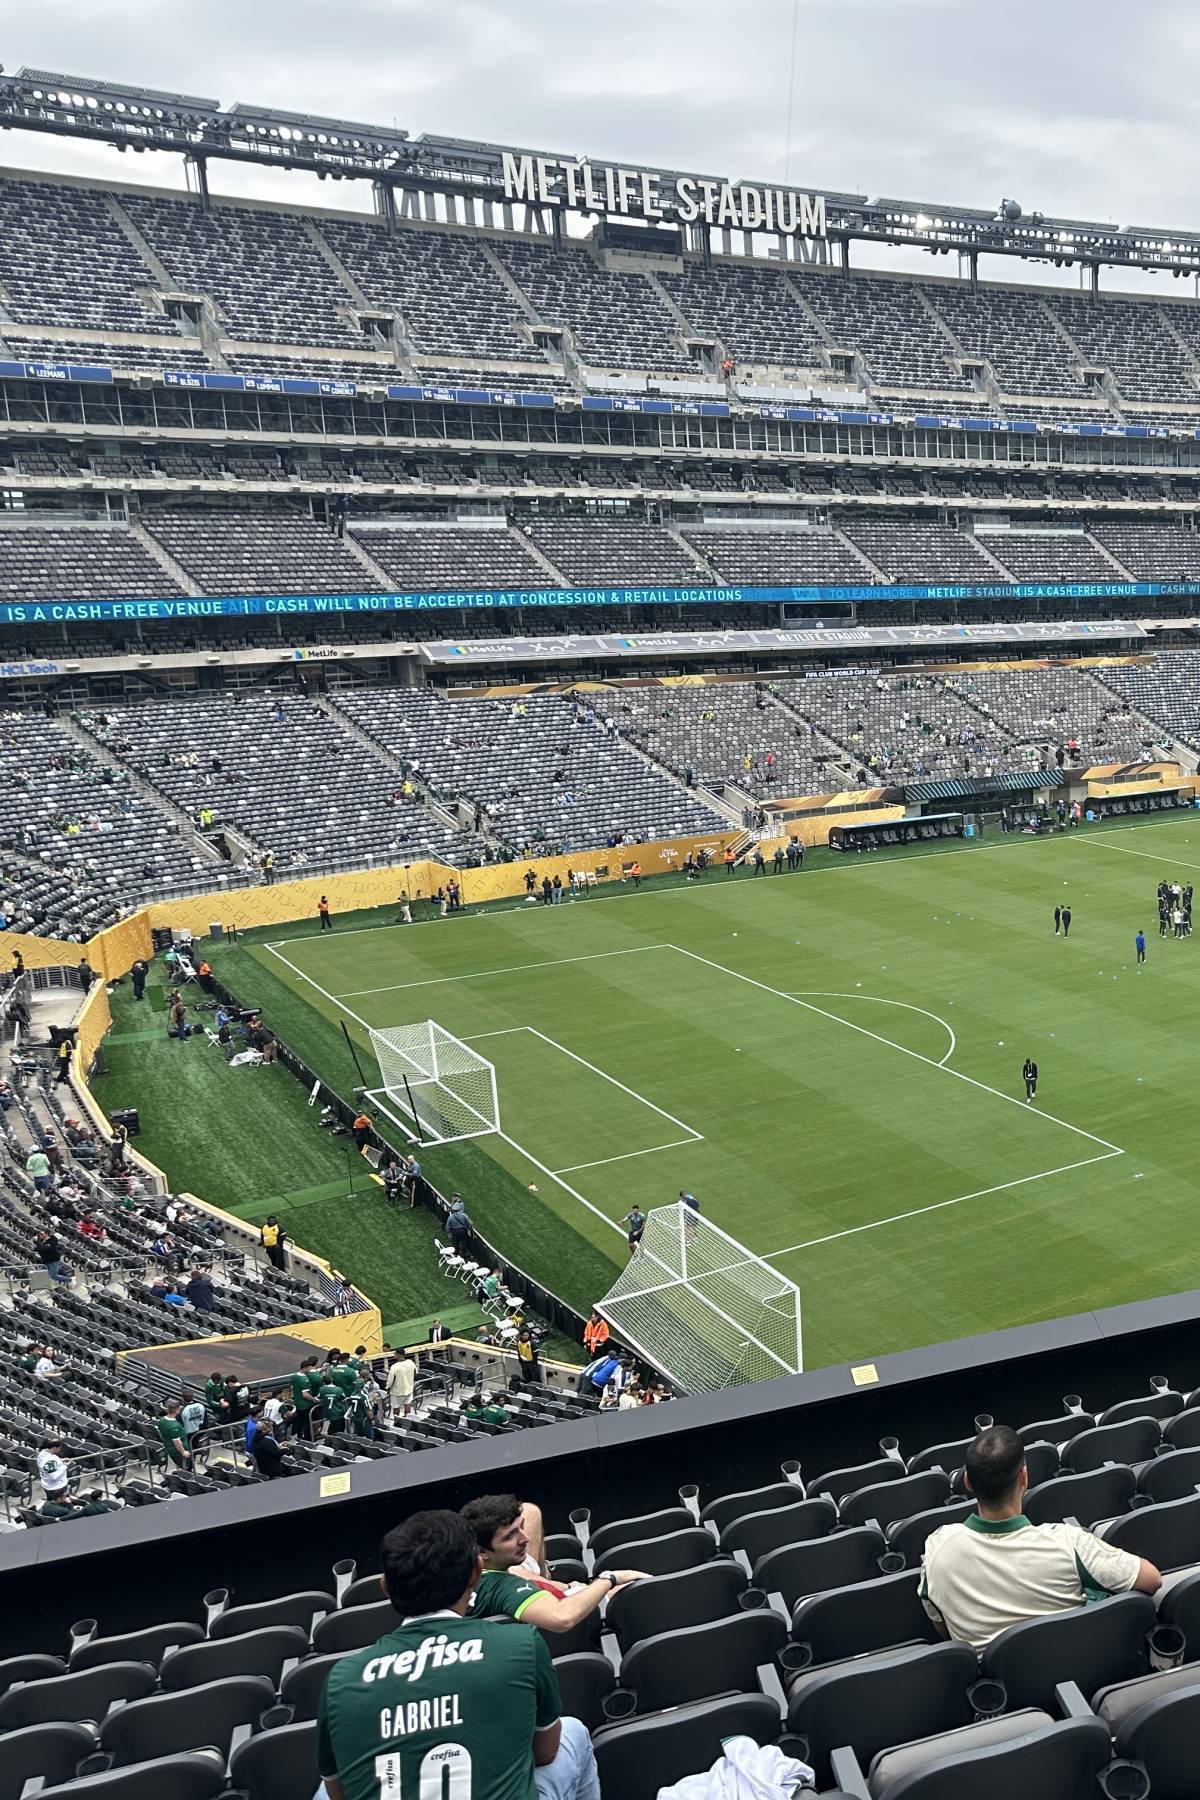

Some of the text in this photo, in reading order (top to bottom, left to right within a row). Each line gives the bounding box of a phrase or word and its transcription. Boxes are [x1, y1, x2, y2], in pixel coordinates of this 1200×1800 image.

[501, 151, 827, 237] METLIFE STADIUM
[167, 375, 178, 383] 32
[927, 588, 973, 598] METLIFE
[976, 586, 1020, 597] STADIUM
[1023, 587, 1033, 596] IS
[1036, 586, 1043, 595] A
[1046, 585, 1102, 596] CASH-FREE
[1105, 585, 1137, 595] VENUE
[1160, 585, 1185, 594] CASH
[8, 608, 26, 621] IS
[34, 608, 46, 620] A
[52, 604, 158, 619] CASH-FREE
[164, 602, 222, 616] VENUE
[265, 600, 307, 613] CASH
[313, 599, 353, 611] WILL
[358, 597, 388, 610] NOT
[393, 597, 413, 609] BE
[418, 594, 493, 608] ACCEPTED
[499, 594, 516, 606] AT
[520, 592, 605, 605] CONCESSION
[610, 592, 620, 602] &
[624, 591, 669, 602] RETAIL
[674, 589, 742, 601] LOCATIONS
[776, 631, 872, 643] METLIFE STADIUM
[467, 645, 513, 653] MetLife
[1, 663, 58, 675] HCLTech
[328, 1397, 334, 1409] 7
[351, 1400, 358, 1412] 7
[362, 1634, 484, 1682] crefisa
[380, 1694, 463, 1738] GABRIEL
[430, 1750, 460, 1761] crefisa
[375, 1743, 472, 1800] 10
